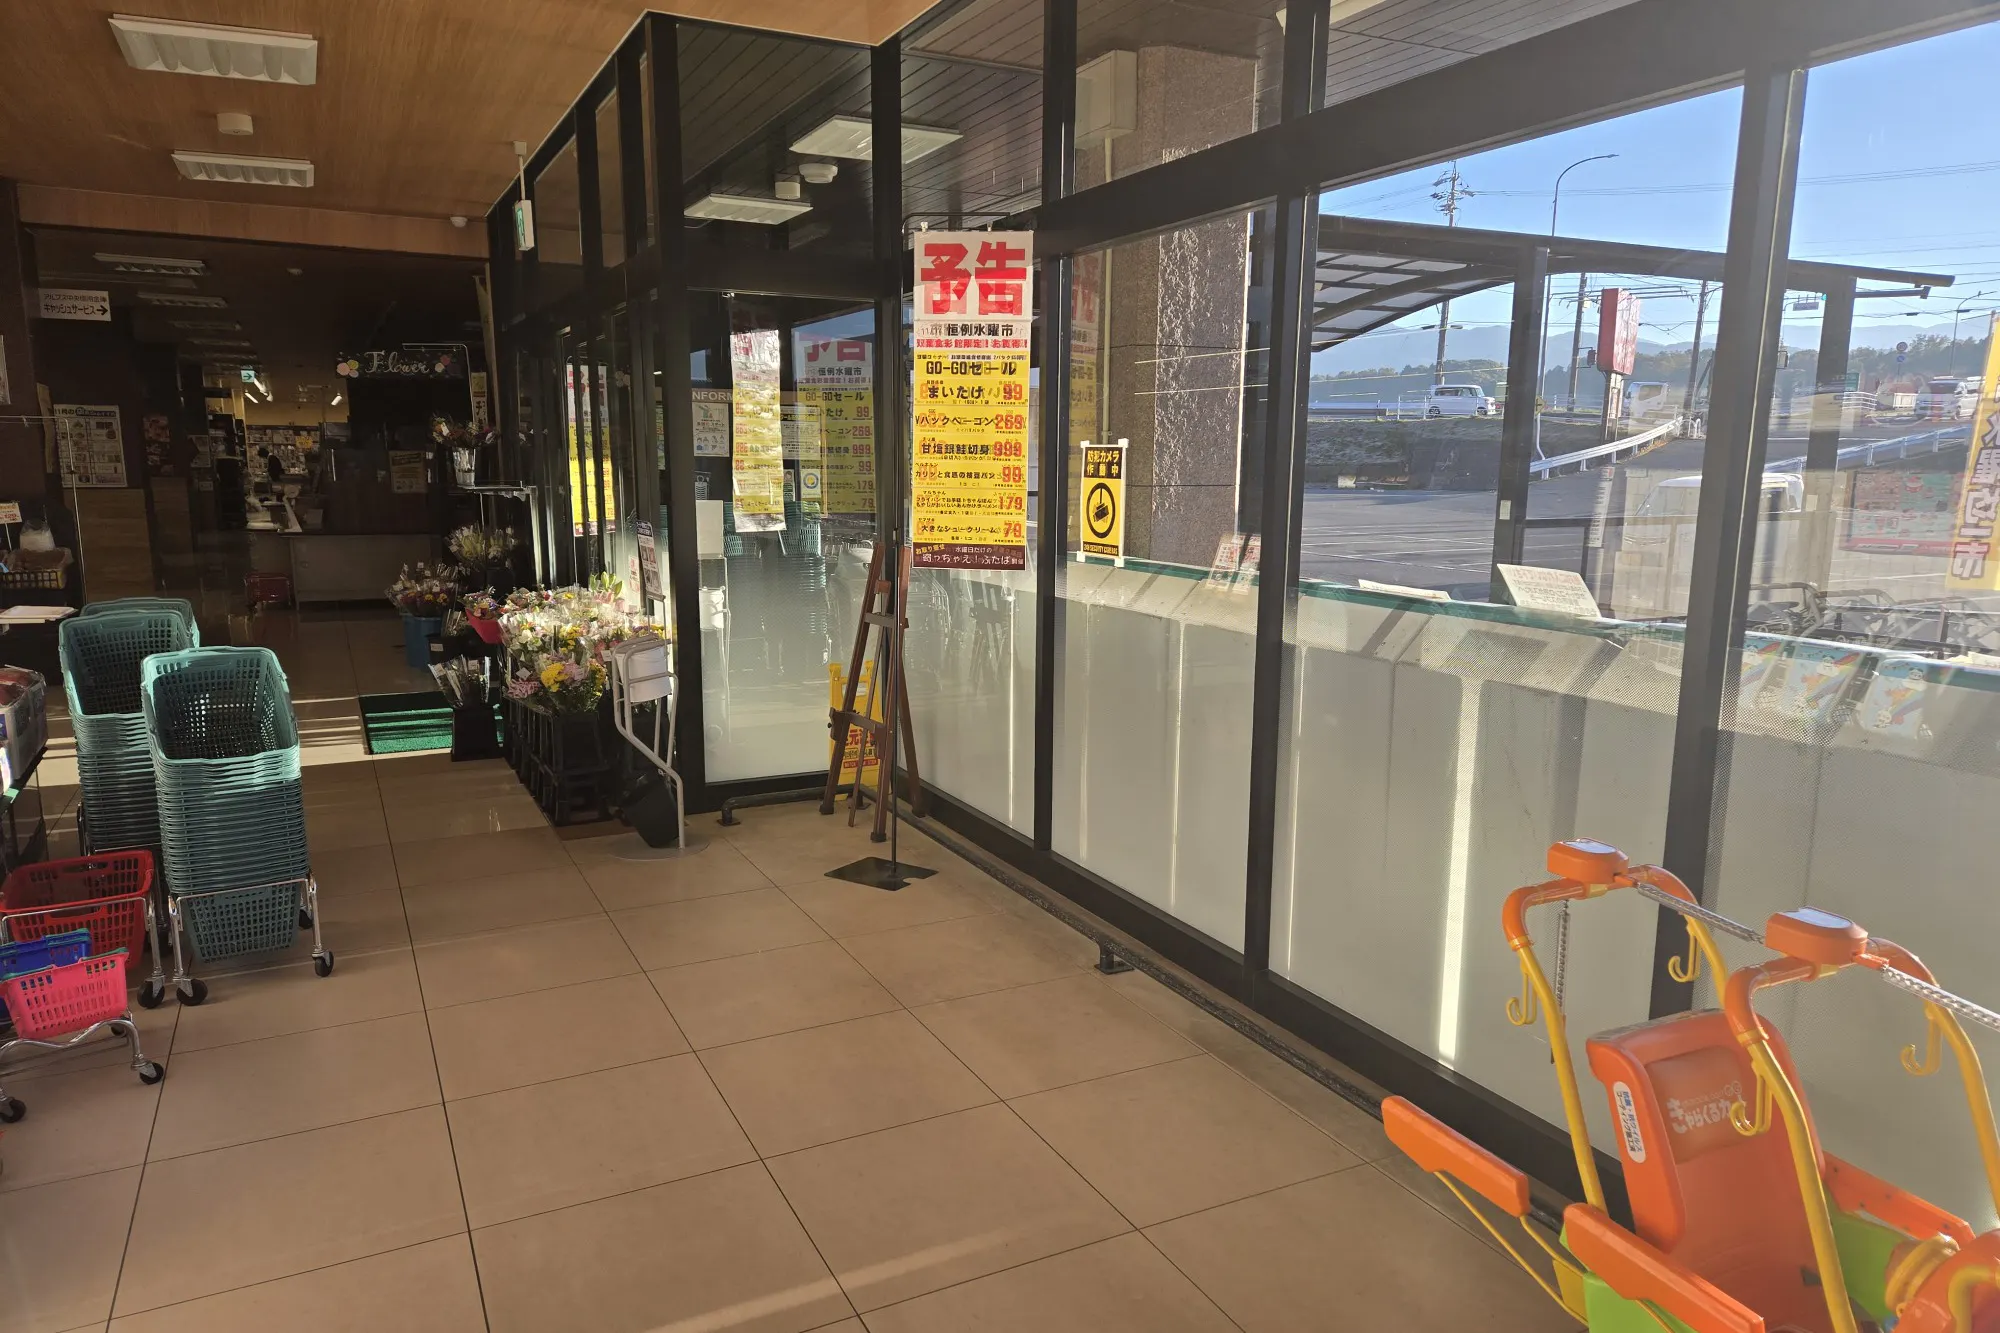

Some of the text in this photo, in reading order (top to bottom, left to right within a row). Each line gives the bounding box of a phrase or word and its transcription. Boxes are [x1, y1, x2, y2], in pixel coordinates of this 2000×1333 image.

[920, 240, 1027, 316] 予告
[43, 304, 96, 315] キャッシュサービス
[947, 323, 1014, 337] 恒例水曜市
[364, 350, 430, 373] Flower
[926, 360, 1017, 375] GO-GOセール
[927, 385, 984, 399] まいたけ
[1087, 450, 1120, 463] 防犯カメラ
[921, 525, 997, 533] 大きなシュークリーム
[955, 546, 993, 554] 水曜日だけの
[1622, 1091, 1644, 1152] 抗菌・抗ウイルス
